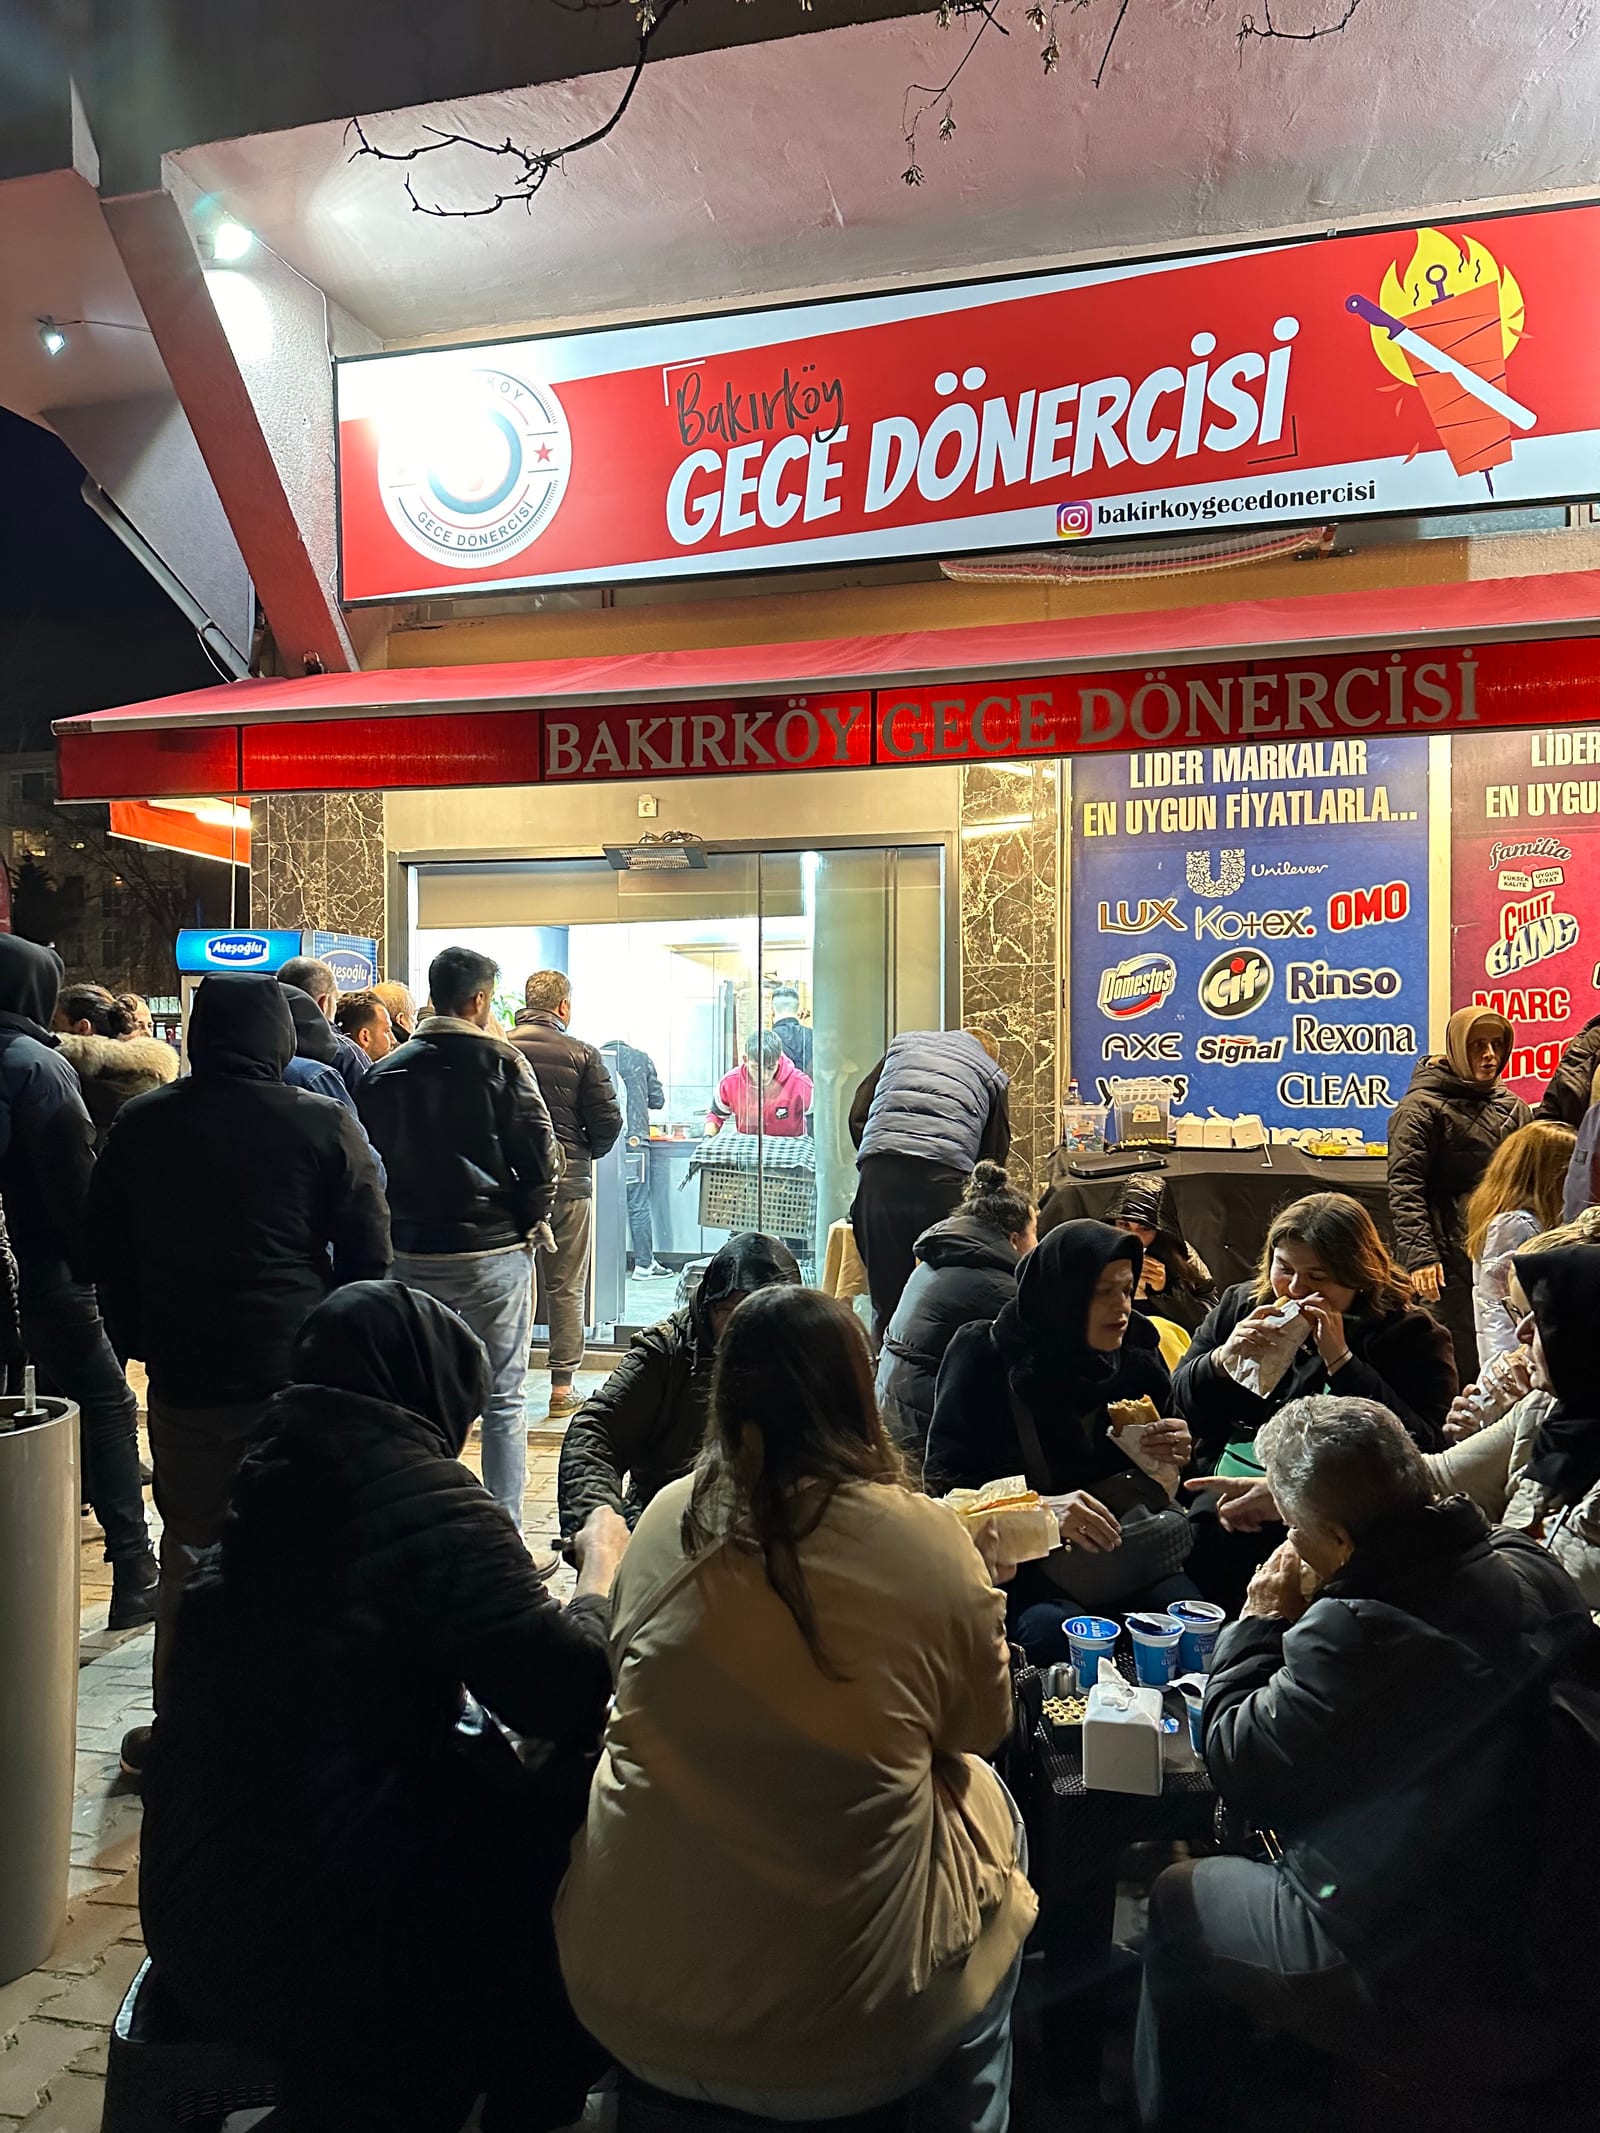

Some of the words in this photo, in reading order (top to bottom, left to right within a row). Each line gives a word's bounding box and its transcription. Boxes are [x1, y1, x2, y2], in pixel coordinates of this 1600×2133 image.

[676, 364, 844, 446] Bakırköy
[666, 424, 849, 546] GECE
[863, 316, 1300, 513] DÖNERCİSİ
[1098, 480, 1376, 524] bakirkoygecedonercisi
[417, 511, 452, 542] GECE
[457, 500, 535, 547] DÖNERCİSİ
[546, 698, 868, 776] BAKIRKÖY
[881, 691, 1057, 758] GECE
[1077, 648, 1480, 745] DÖNERCİSİ
[1212, 740, 1368, 784] MARKALAR
[1532, 729, 1600, 767] LİDER
[1084, 802, 1117, 837] EN
[1125, 795, 1217, 835] UYGUN
[1486, 785, 1518, 818] EN
[1251, 862, 1328, 877] Unilever
[1489, 838, 1571, 870] familia
[1535, 870, 1559, 879] UYGUN
[1099, 900, 1187, 933] LUX
[1329, 881, 1408, 931] OMO
[1504, 894, 1551, 941] CILLIT
[212, 941, 262, 956] Ateşoğlu
[1487, 915, 1577, 976] BANG
[1102, 967, 1174, 1004] Domestos
[1207, 957, 1261, 1009] Cif
[1291, 964, 1397, 1000] Rinso
[1104, 1034, 1182, 1059] AXE
[1199, 1038, 1282, 1064] Signal
[1295, 1017, 1416, 1053] Rexona
[1279, 1074, 1396, 1106] CLEAR
